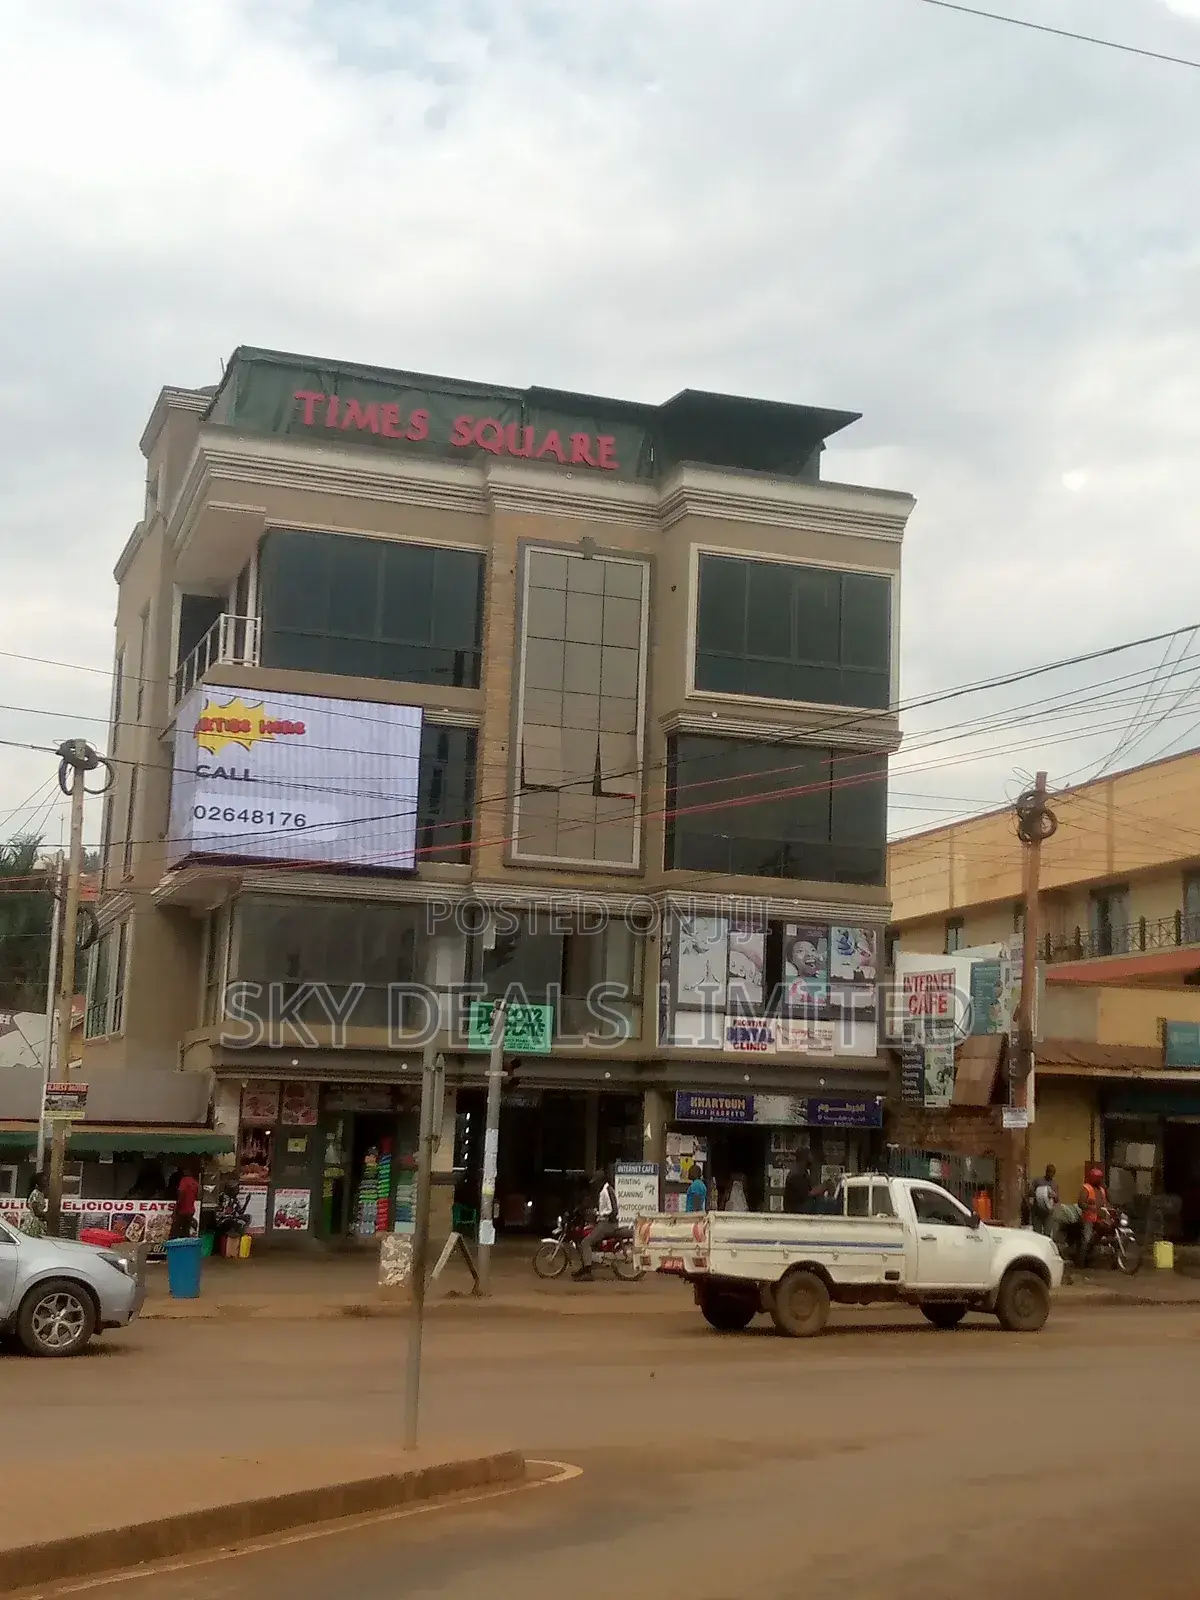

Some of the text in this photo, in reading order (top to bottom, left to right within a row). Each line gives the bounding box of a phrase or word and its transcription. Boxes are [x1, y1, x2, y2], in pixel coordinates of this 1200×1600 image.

[294, 391, 620, 470] TIMES SQUARE
[195, 764, 251, 781] CALL
[194, 805, 306, 828] 02648176
[903, 972, 955, 990] INTERNET
[908, 994, 948, 1015] CAFE
[690, 1096, 746, 1110] KHARTOUM
[617, 1164, 642, 1174] INTERNET
[617, 1178, 642, 1186] PRINTING
[617, 1190, 643, 1199] SCANNING
[61, 1201, 134, 1211] ELICIOUS
